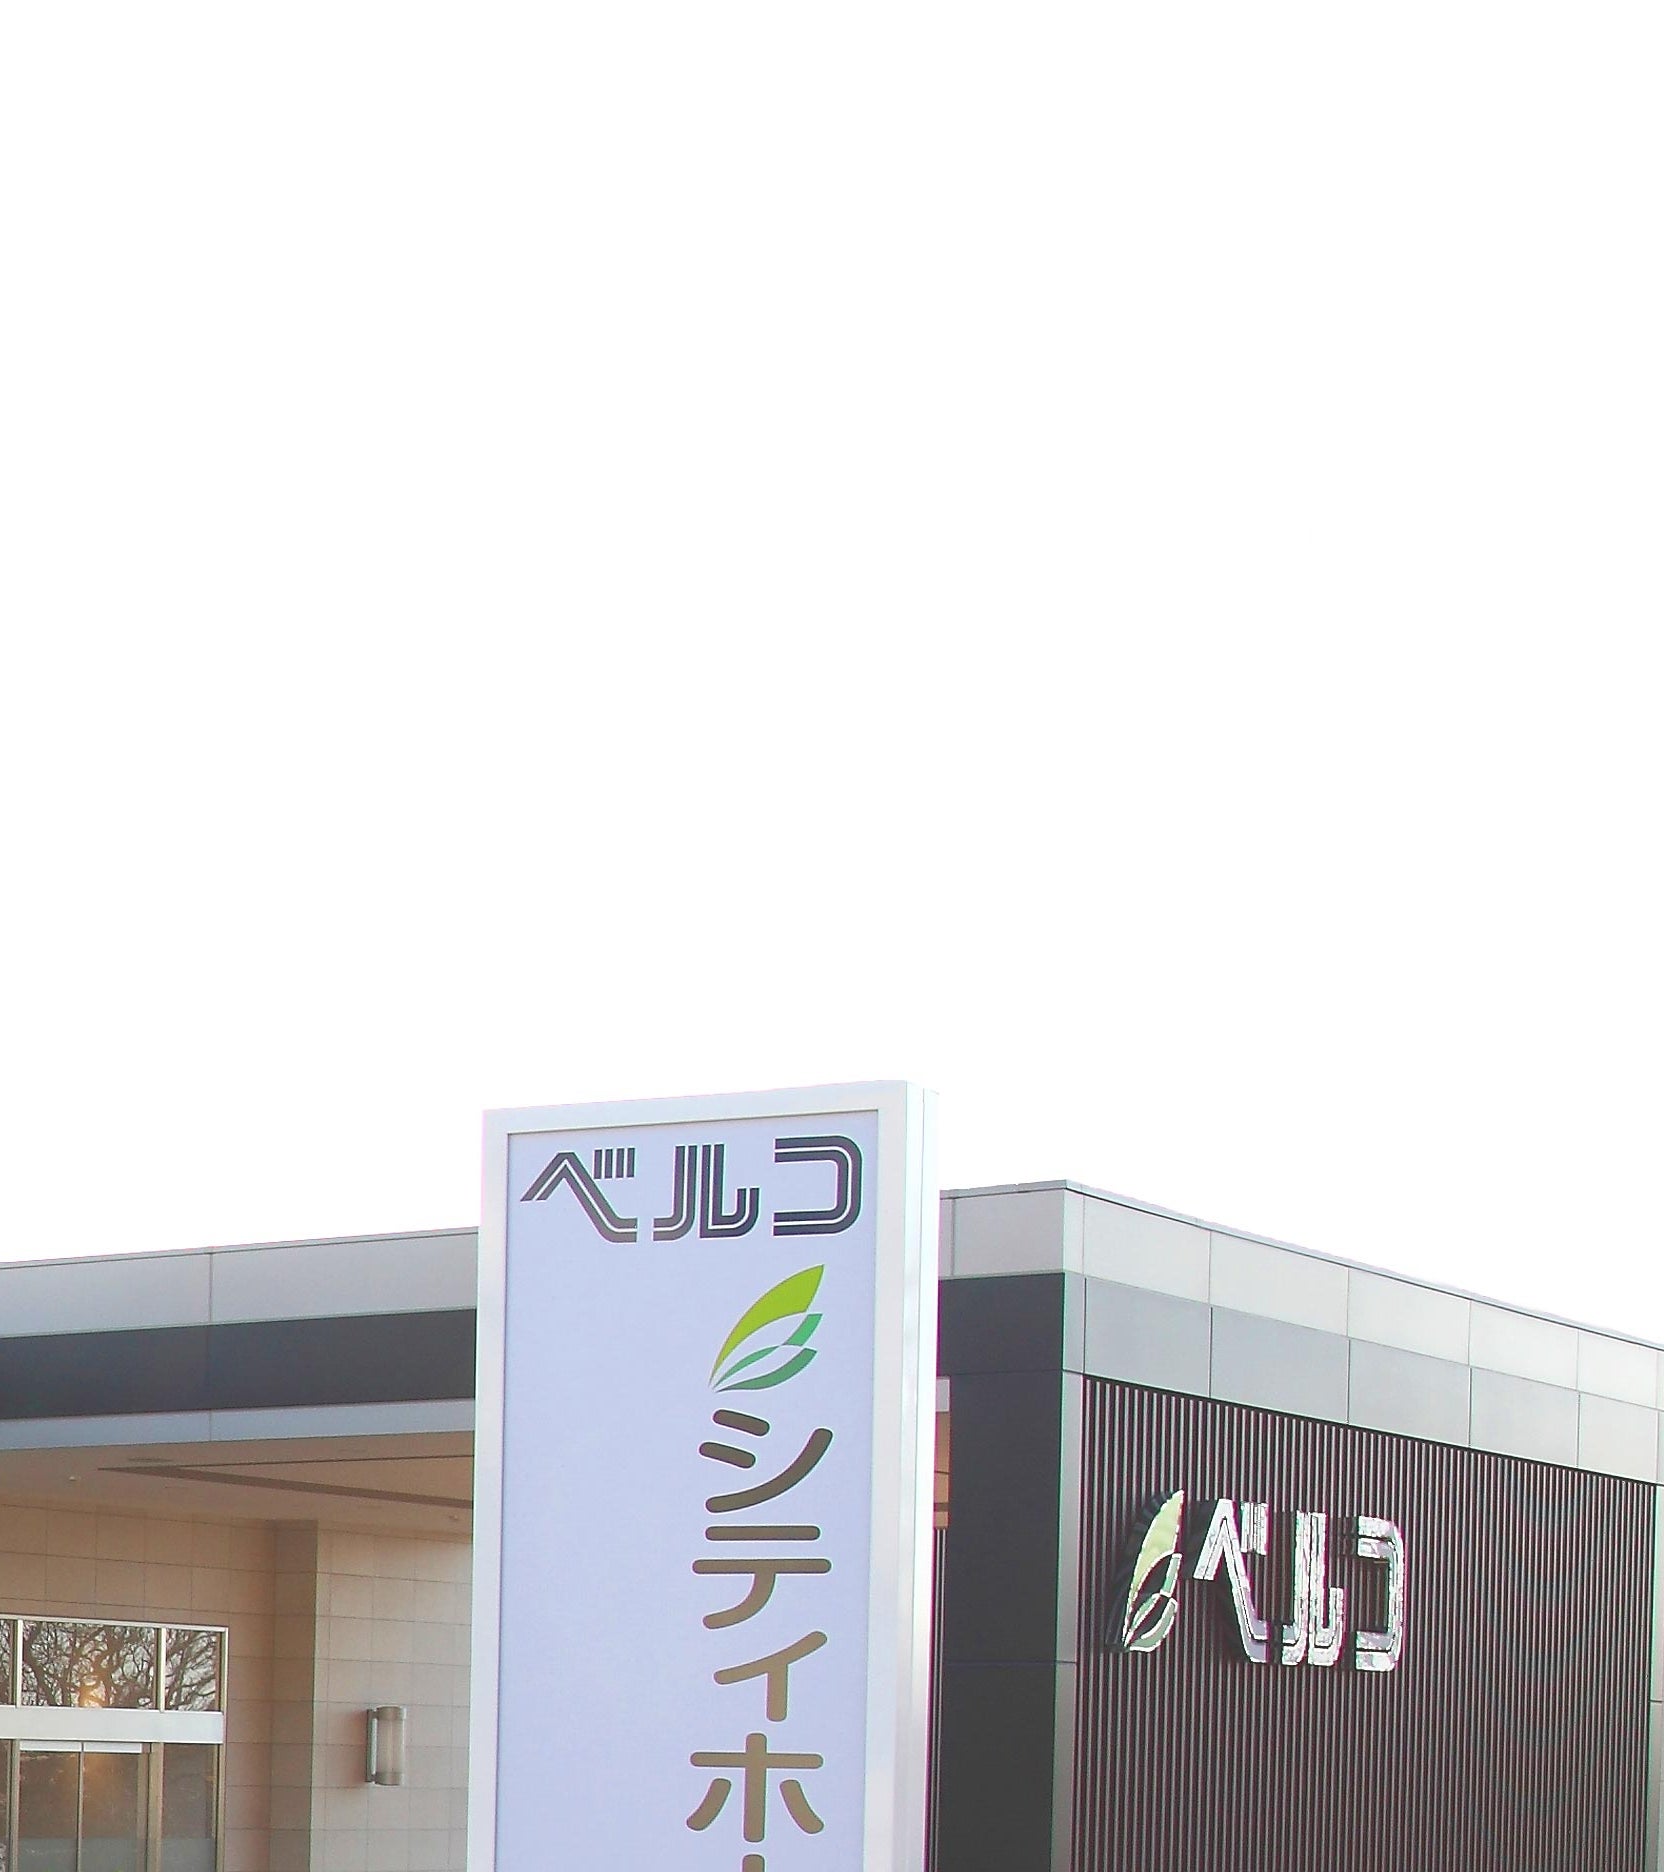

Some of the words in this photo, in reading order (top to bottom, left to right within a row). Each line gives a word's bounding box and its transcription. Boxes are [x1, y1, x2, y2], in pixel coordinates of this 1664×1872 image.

[520, 1135, 863, 1243] ベルコ
[1193, 1498, 1406, 1672] ベルコ
